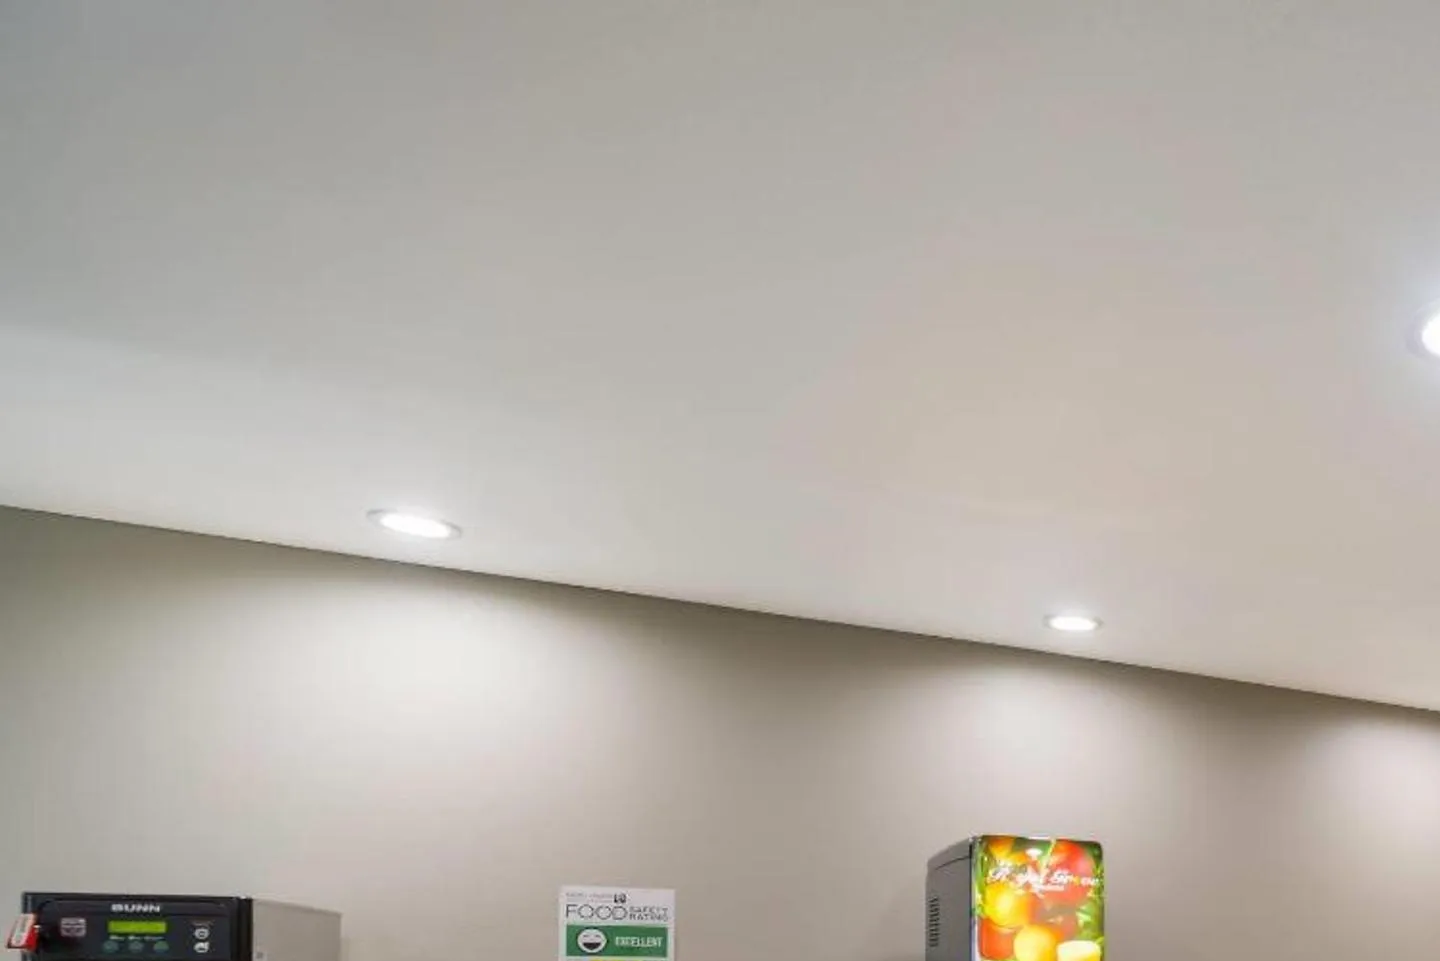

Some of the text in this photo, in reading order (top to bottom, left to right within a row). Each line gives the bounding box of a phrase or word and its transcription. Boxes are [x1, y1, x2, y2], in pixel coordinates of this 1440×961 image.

[111, 903, 161, 913] BUNN
[566, 904, 628, 920] FOOD
[615, 936, 662, 947] EXCELLENT
